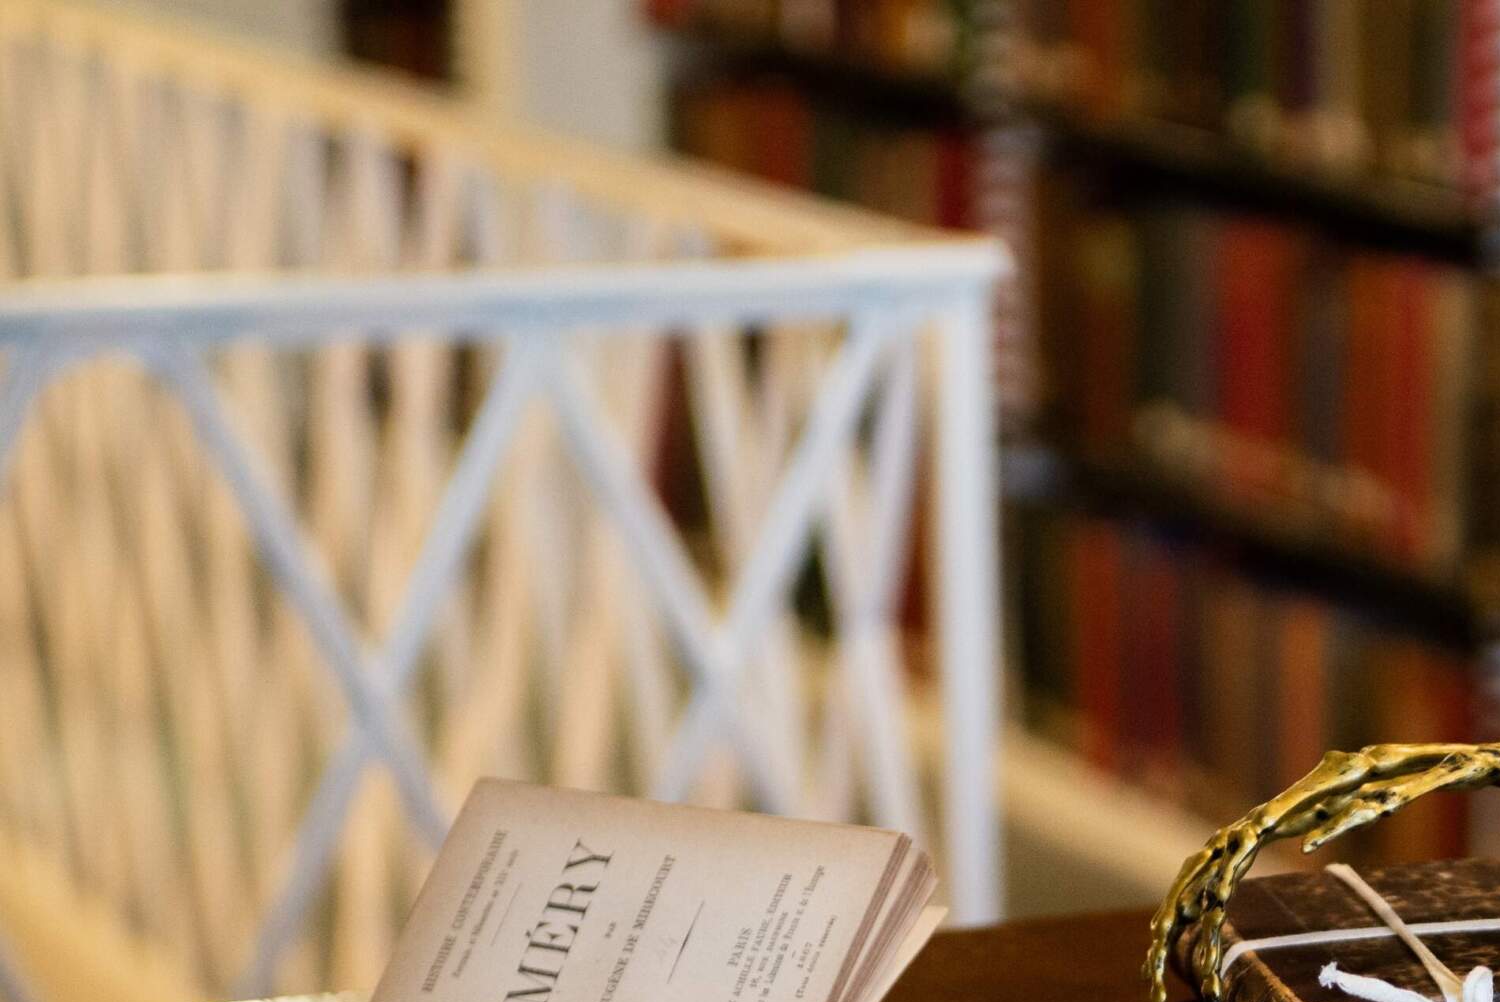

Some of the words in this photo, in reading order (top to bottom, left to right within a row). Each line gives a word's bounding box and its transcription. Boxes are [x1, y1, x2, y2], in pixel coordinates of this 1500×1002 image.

[622, 934, 639, 953] DE
[632, 855, 676, 930] MIRECOURT
[727, 928, 752, 967] PARIS
[732, 956, 755, 997] ACHILLE
